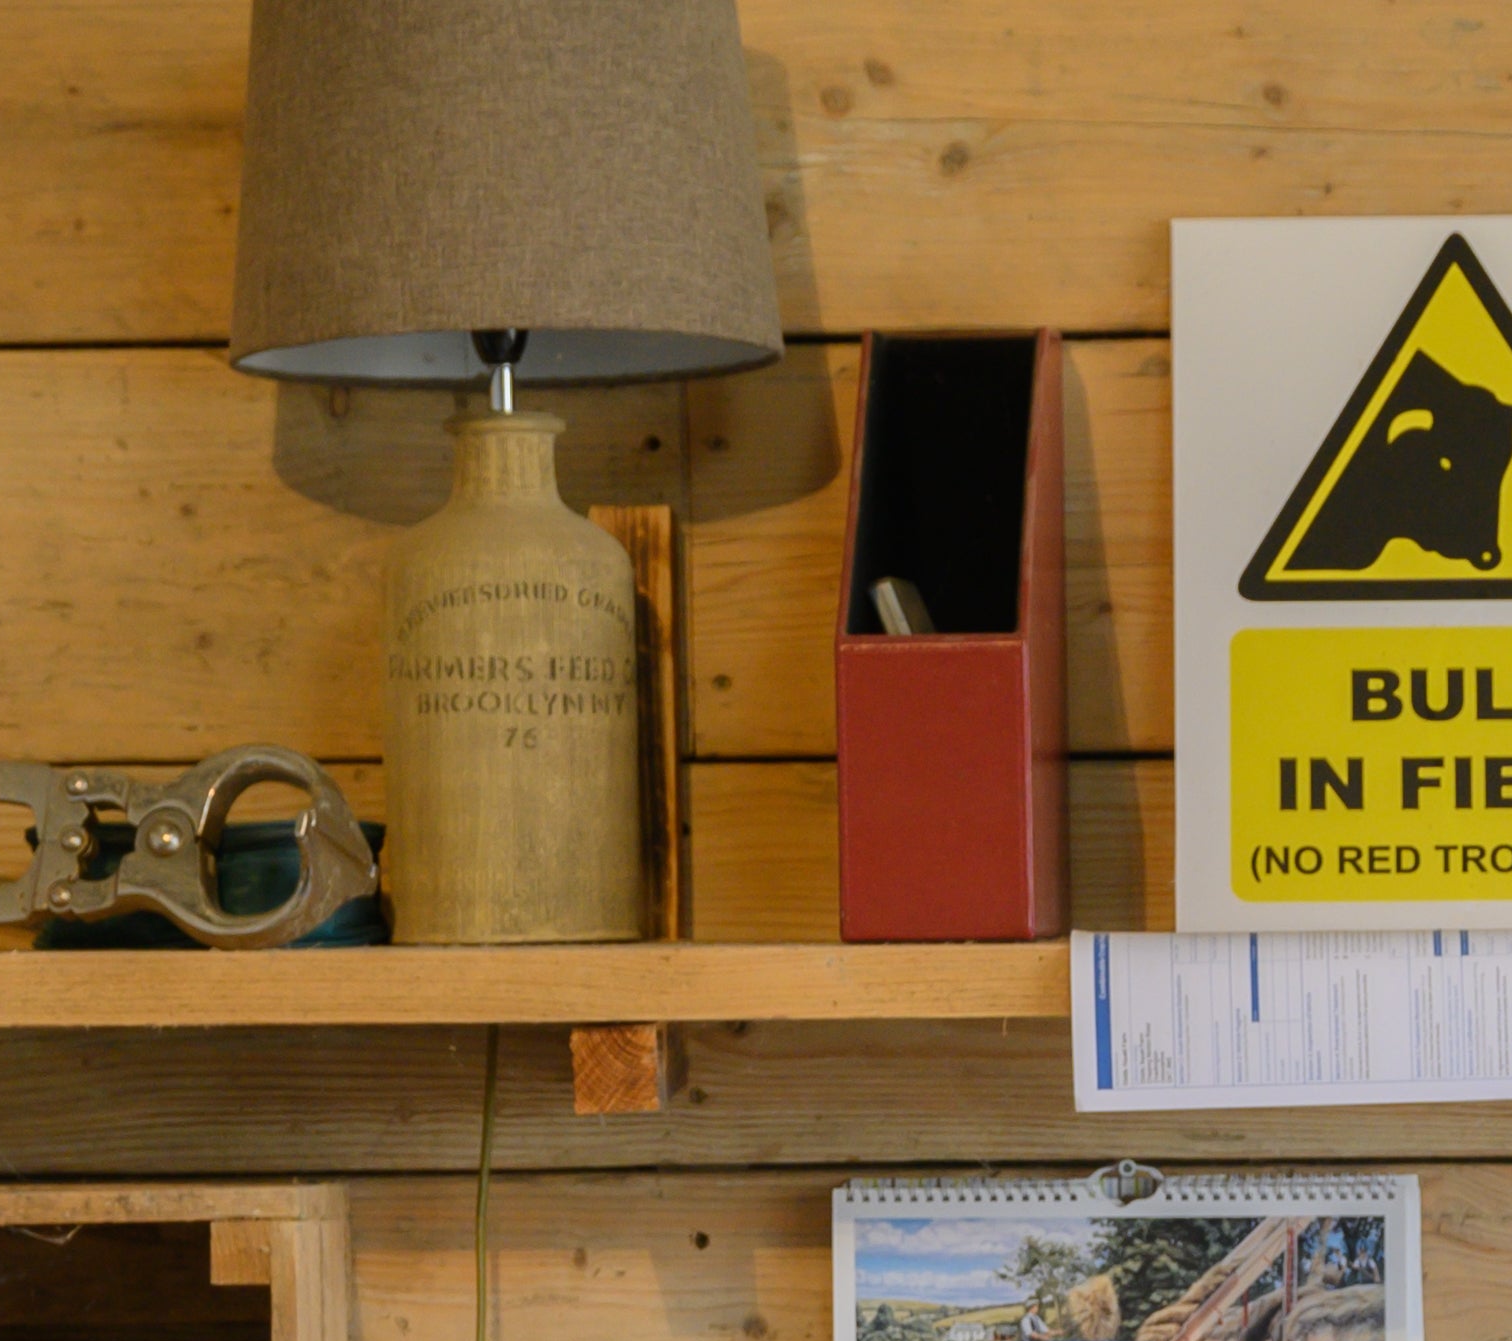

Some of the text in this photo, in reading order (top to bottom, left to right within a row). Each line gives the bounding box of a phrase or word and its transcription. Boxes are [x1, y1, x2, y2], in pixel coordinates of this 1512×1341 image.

[1279, 757, 1364, 810] IN
[1250, 845, 1323, 881] (NO
[1339, 845, 1419, 874] RED
